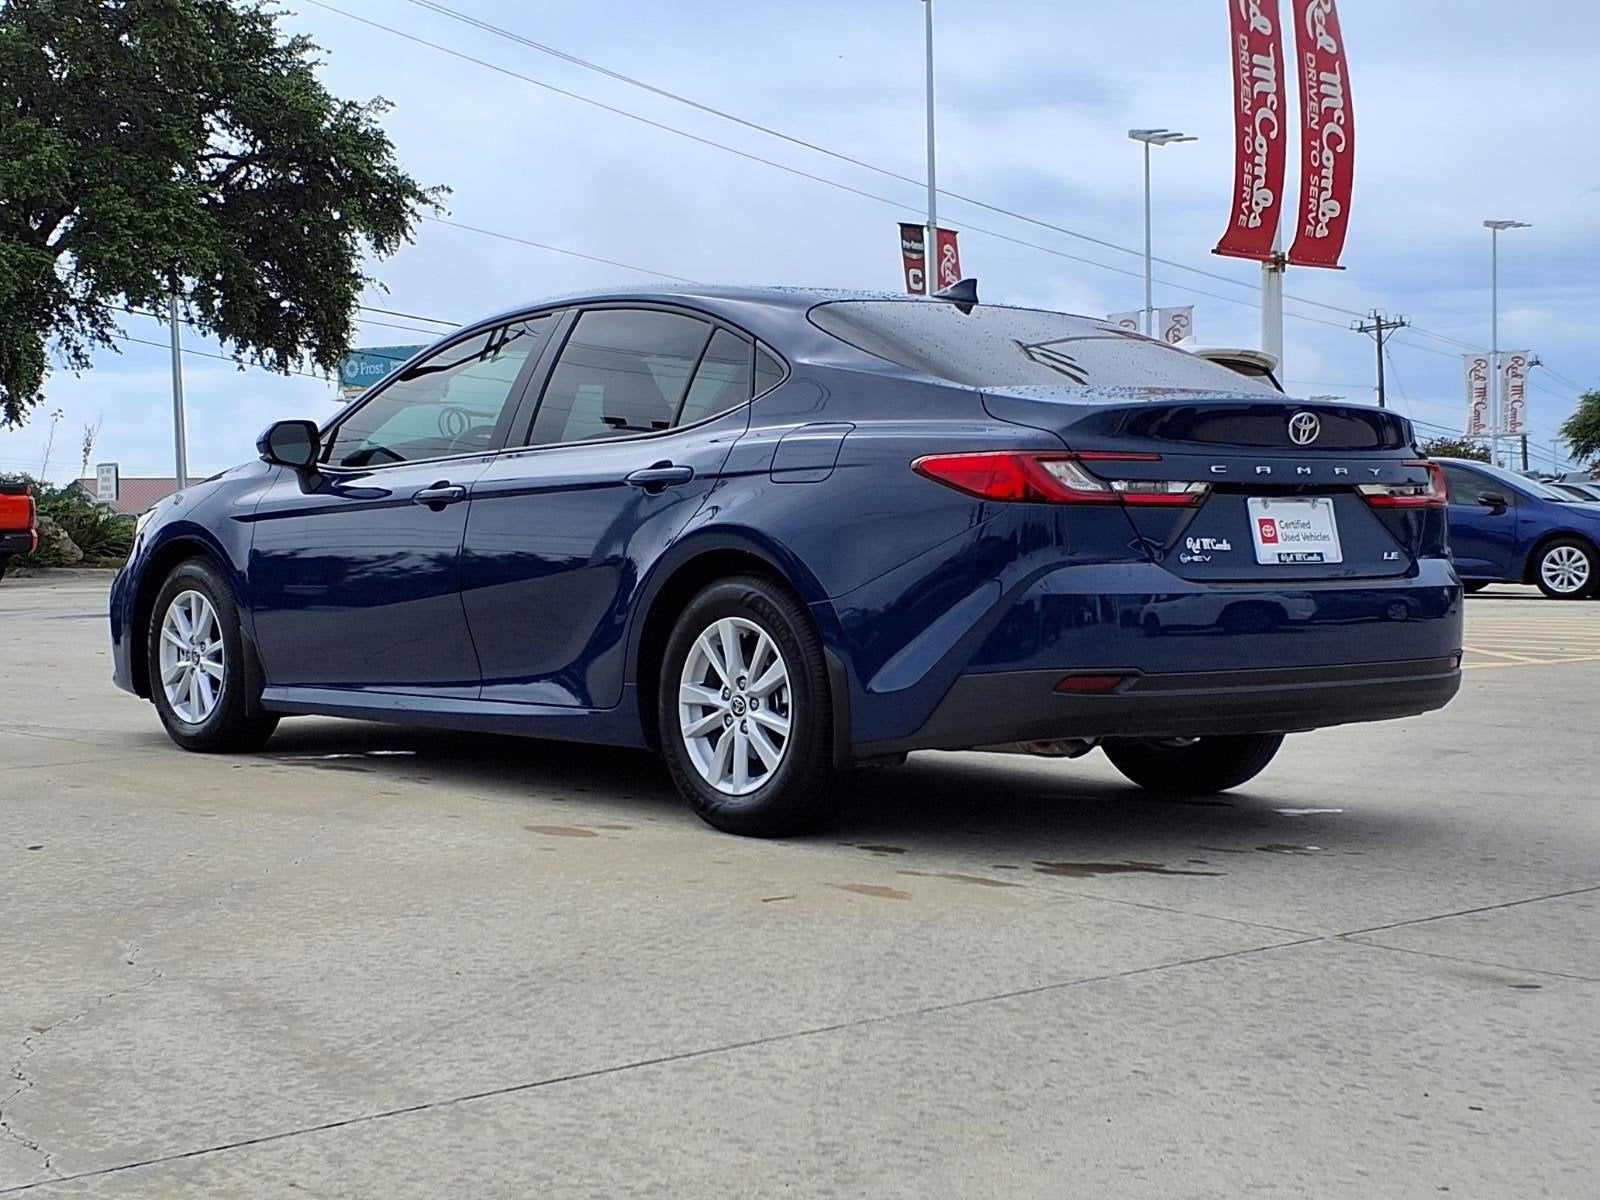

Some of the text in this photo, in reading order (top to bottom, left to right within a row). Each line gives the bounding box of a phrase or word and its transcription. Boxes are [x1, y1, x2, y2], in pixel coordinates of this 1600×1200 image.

[1237, 33, 1253, 228] DRIVEN TO SERVE
[1305, 51, 1320, 238] DRIVEN TO SERVE
[360, 362, 384, 375] Frost
[1469, 358, 1488, 381] Red
[1506, 356, 1526, 379] Red
[1279, 520, 1311, 530] Certified
[1281, 532, 1330, 541] Used Vehicles
[1383, 551, 1400, 560] LE
